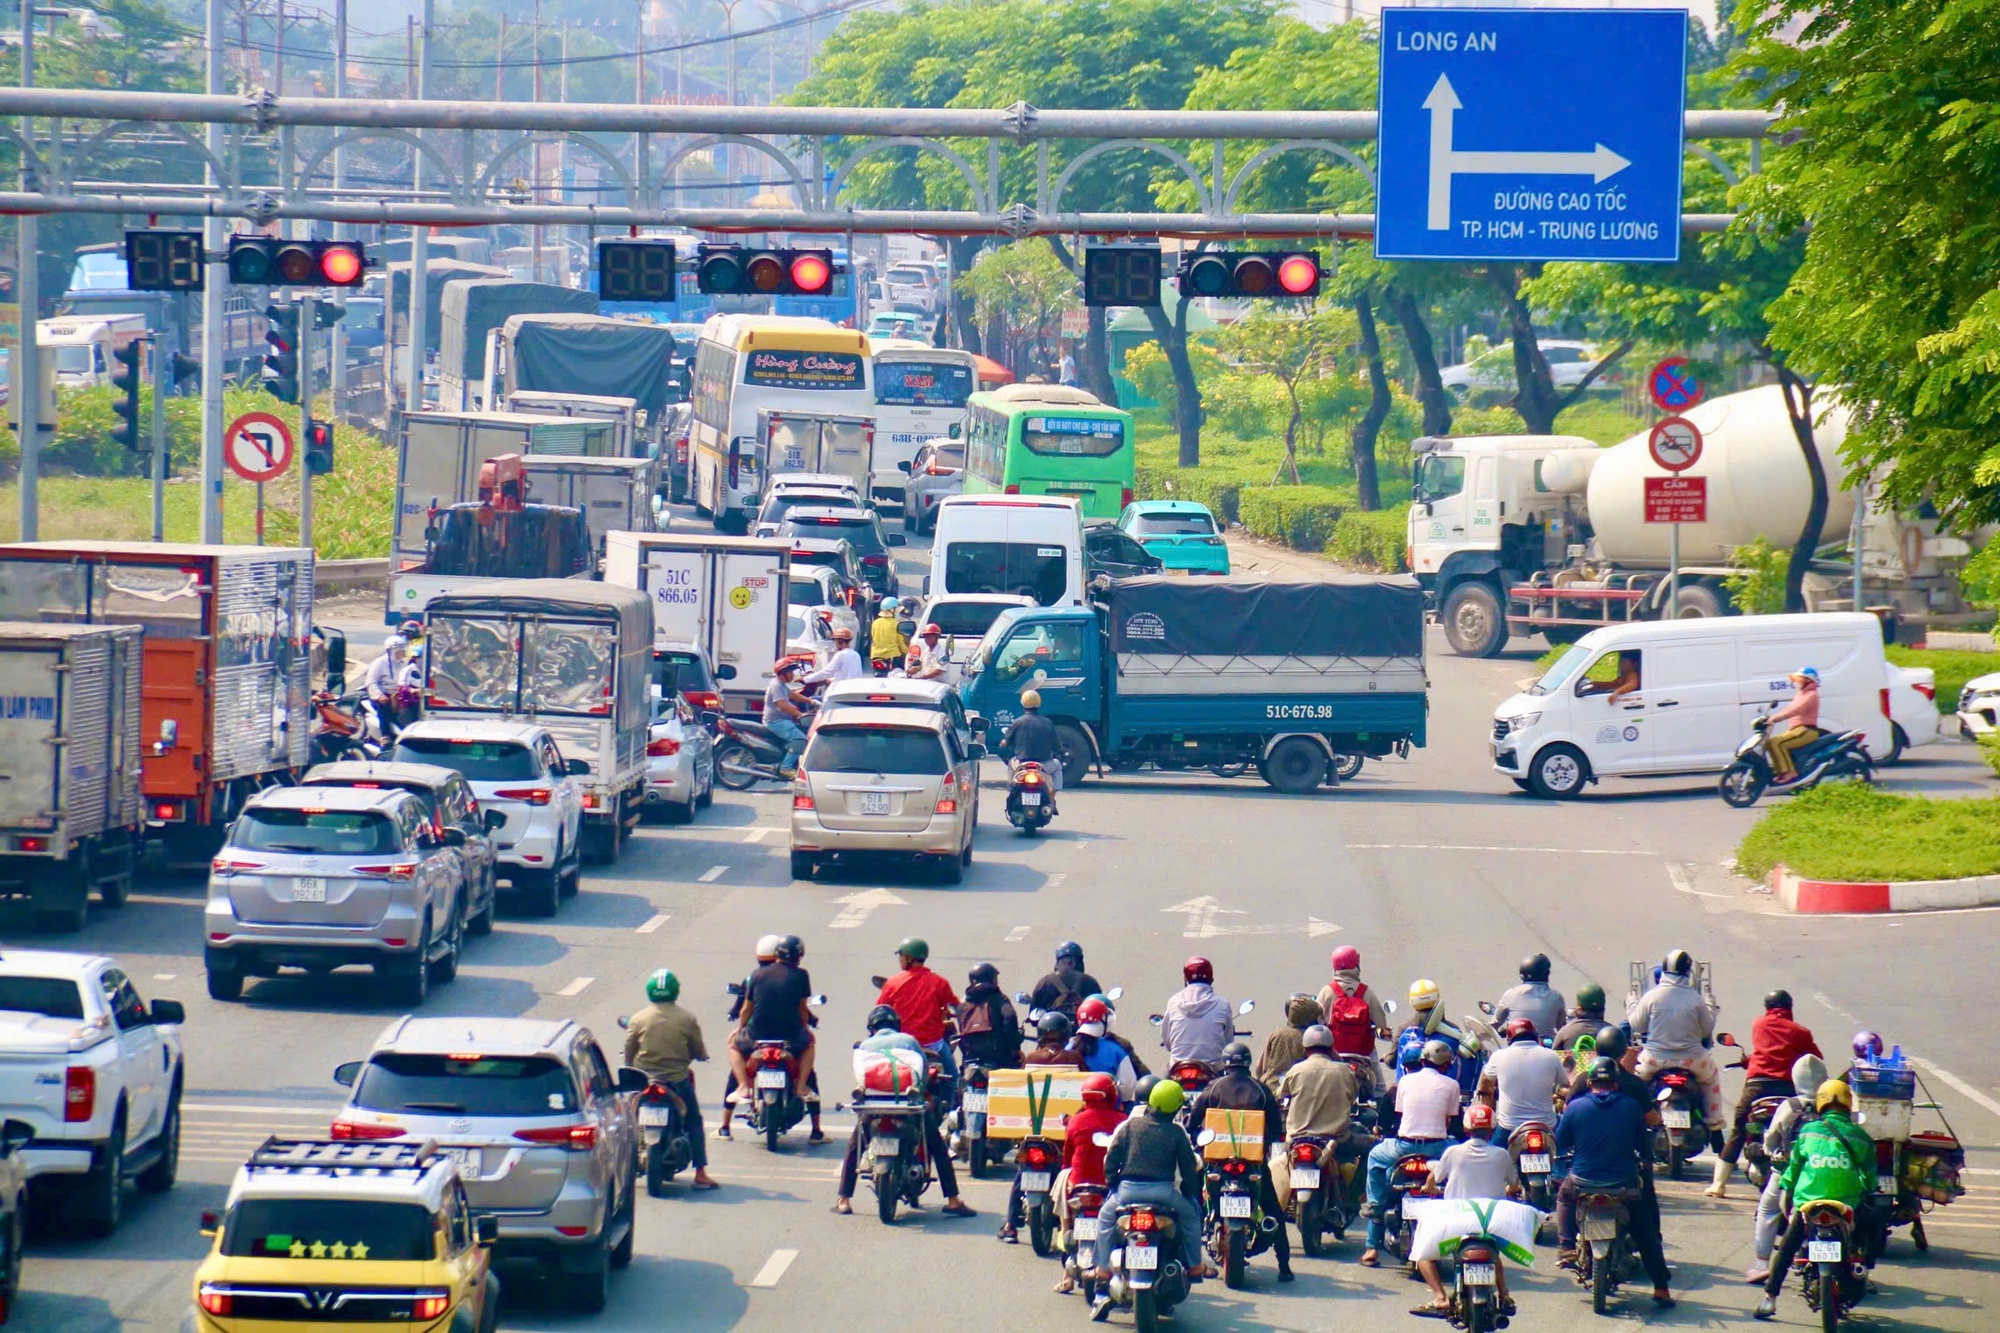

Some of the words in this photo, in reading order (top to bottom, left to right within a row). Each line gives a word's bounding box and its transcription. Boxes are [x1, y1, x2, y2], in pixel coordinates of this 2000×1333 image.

[1397, 31, 1458, 51] LONG
[1464, 31, 1497, 51] AN
[1494, 185, 1553, 211] ĐƯỜNG
[1558, 193, 1590, 211] CAO
[1595, 185, 1627, 211] TỐC
[1462, 221, 1482, 239] TP.
[1488, 221, 1524, 239] HCM
[1540, 222, 1596, 240] TRUNG
[1601, 221, 1659, 240] LƯƠNG
[666, 569, 691, 585] 51C
[744, 579, 767, 587] STOP
[658, 587, 697, 604] 866.05
[1266, 705, 1332, 718] 51C-676.98
[1809, 1152, 1850, 1169] Grab
